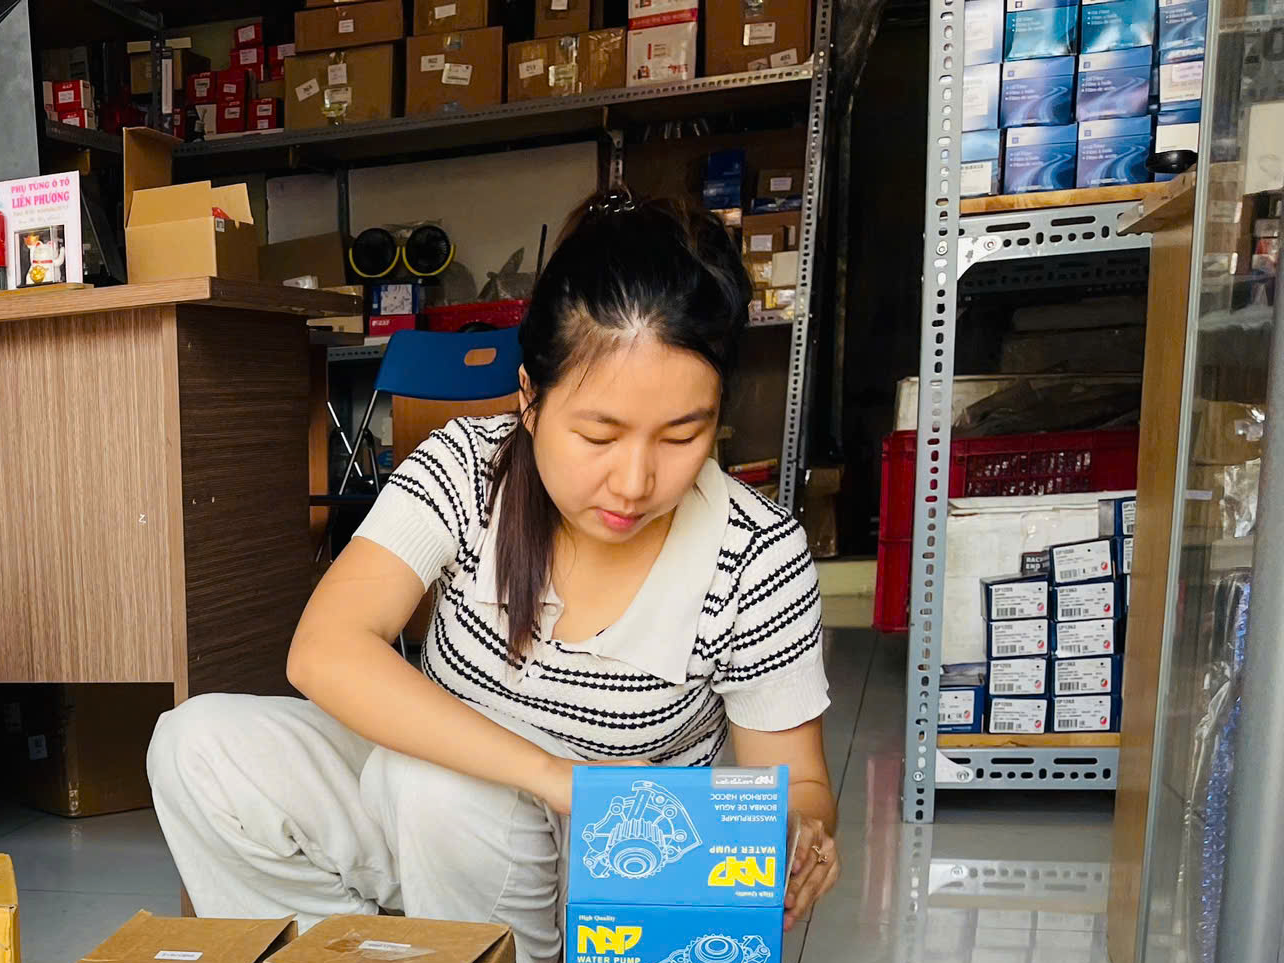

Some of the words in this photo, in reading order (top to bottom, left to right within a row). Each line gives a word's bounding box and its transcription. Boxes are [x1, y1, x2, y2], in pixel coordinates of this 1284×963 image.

[709, 846, 738, 854] PUMP
[740, 846, 776, 854] WATER
[707, 856, 776, 887] NAP
[594, 915, 616, 923] Quality
[577, 925, 643, 955] NAP
[577, 956, 610, 963] WATER
